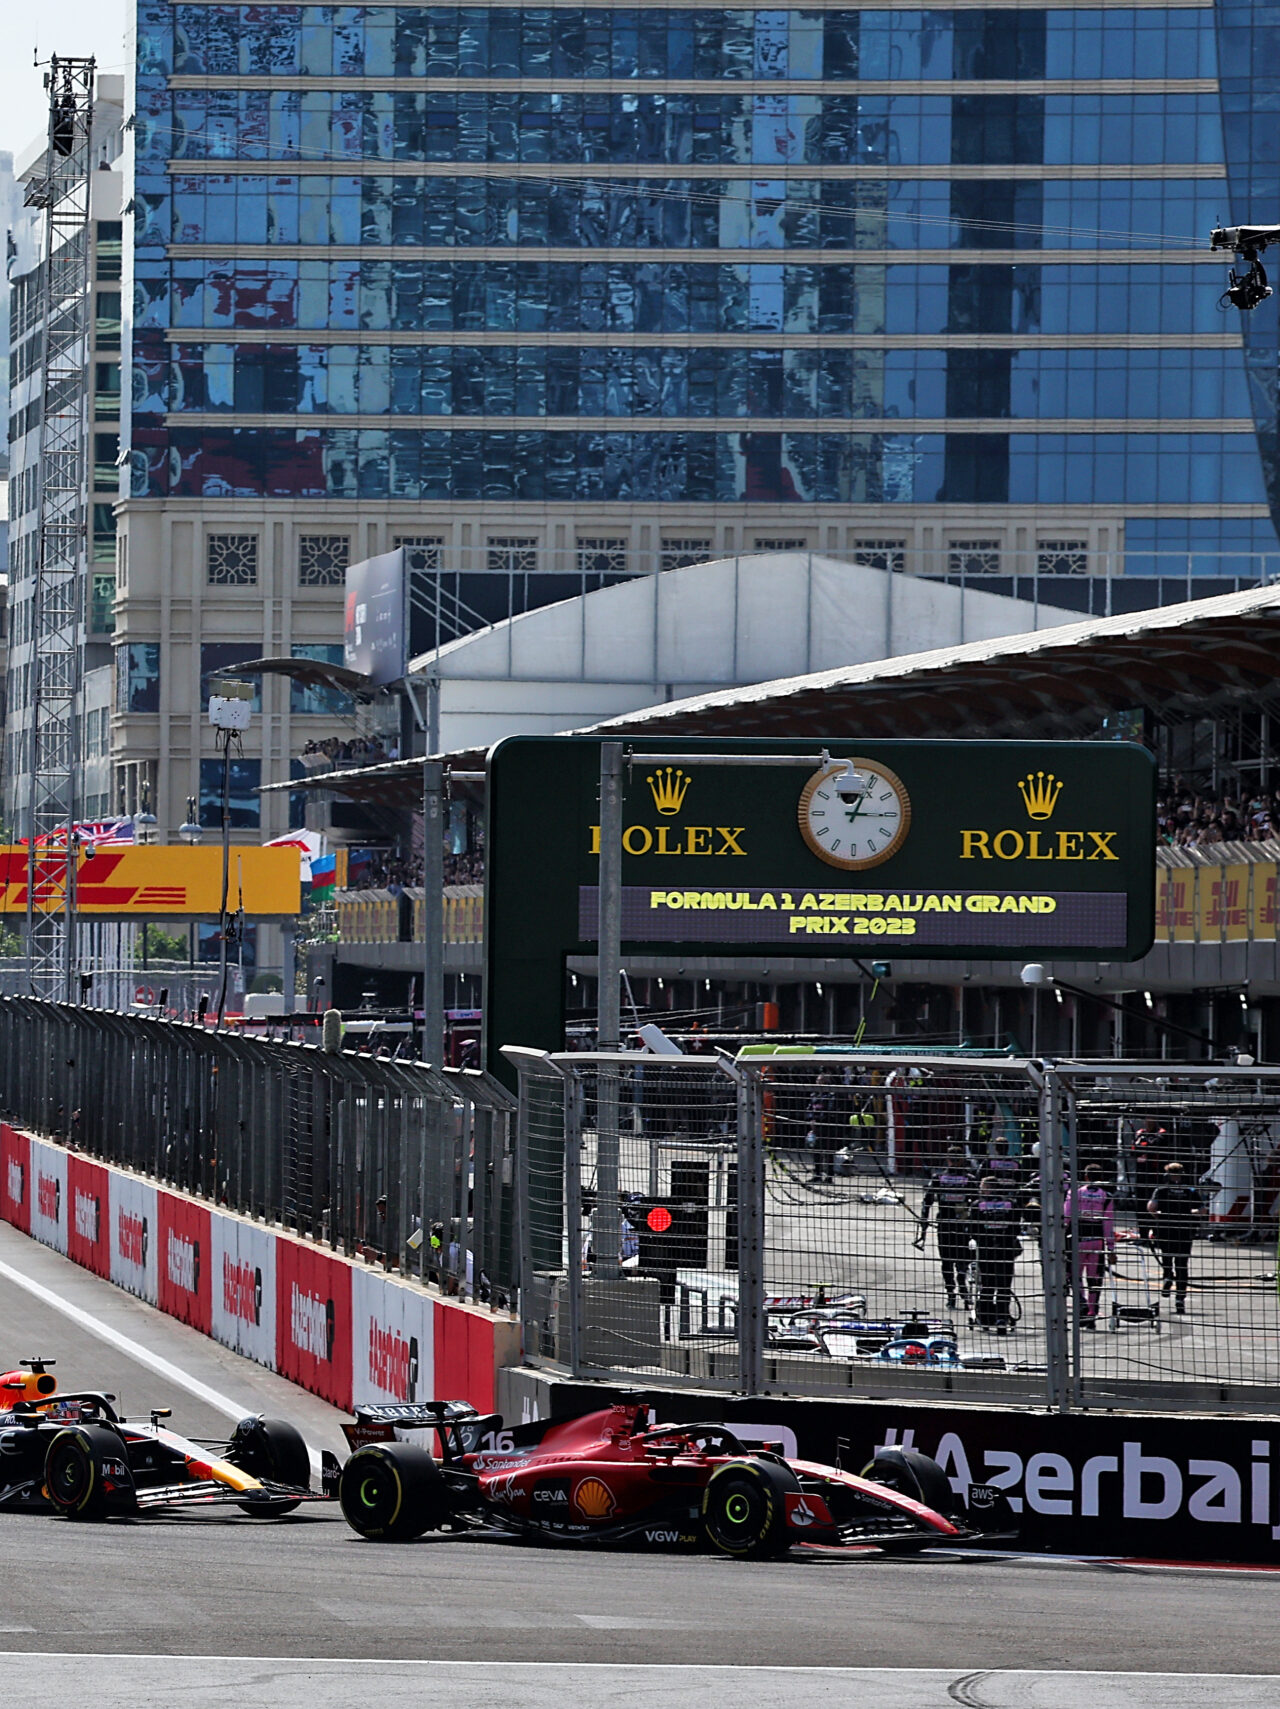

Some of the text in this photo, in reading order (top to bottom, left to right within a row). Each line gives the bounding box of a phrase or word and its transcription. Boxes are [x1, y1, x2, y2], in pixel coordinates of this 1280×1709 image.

[959, 829, 1119, 860] ROLEX
[650, 891, 1057, 914] FORMULA 1 AZERBAIJAN GRAND
[789, 916, 916, 935] PRIX 2023
[481, 1431, 515, 1453] 16
[101, 1463, 125, 1476] Mobil
[485, 1458, 531, 1470] Santander
[972, 1488, 994, 1499] aws
[645, 1530, 679, 1542] VGW
